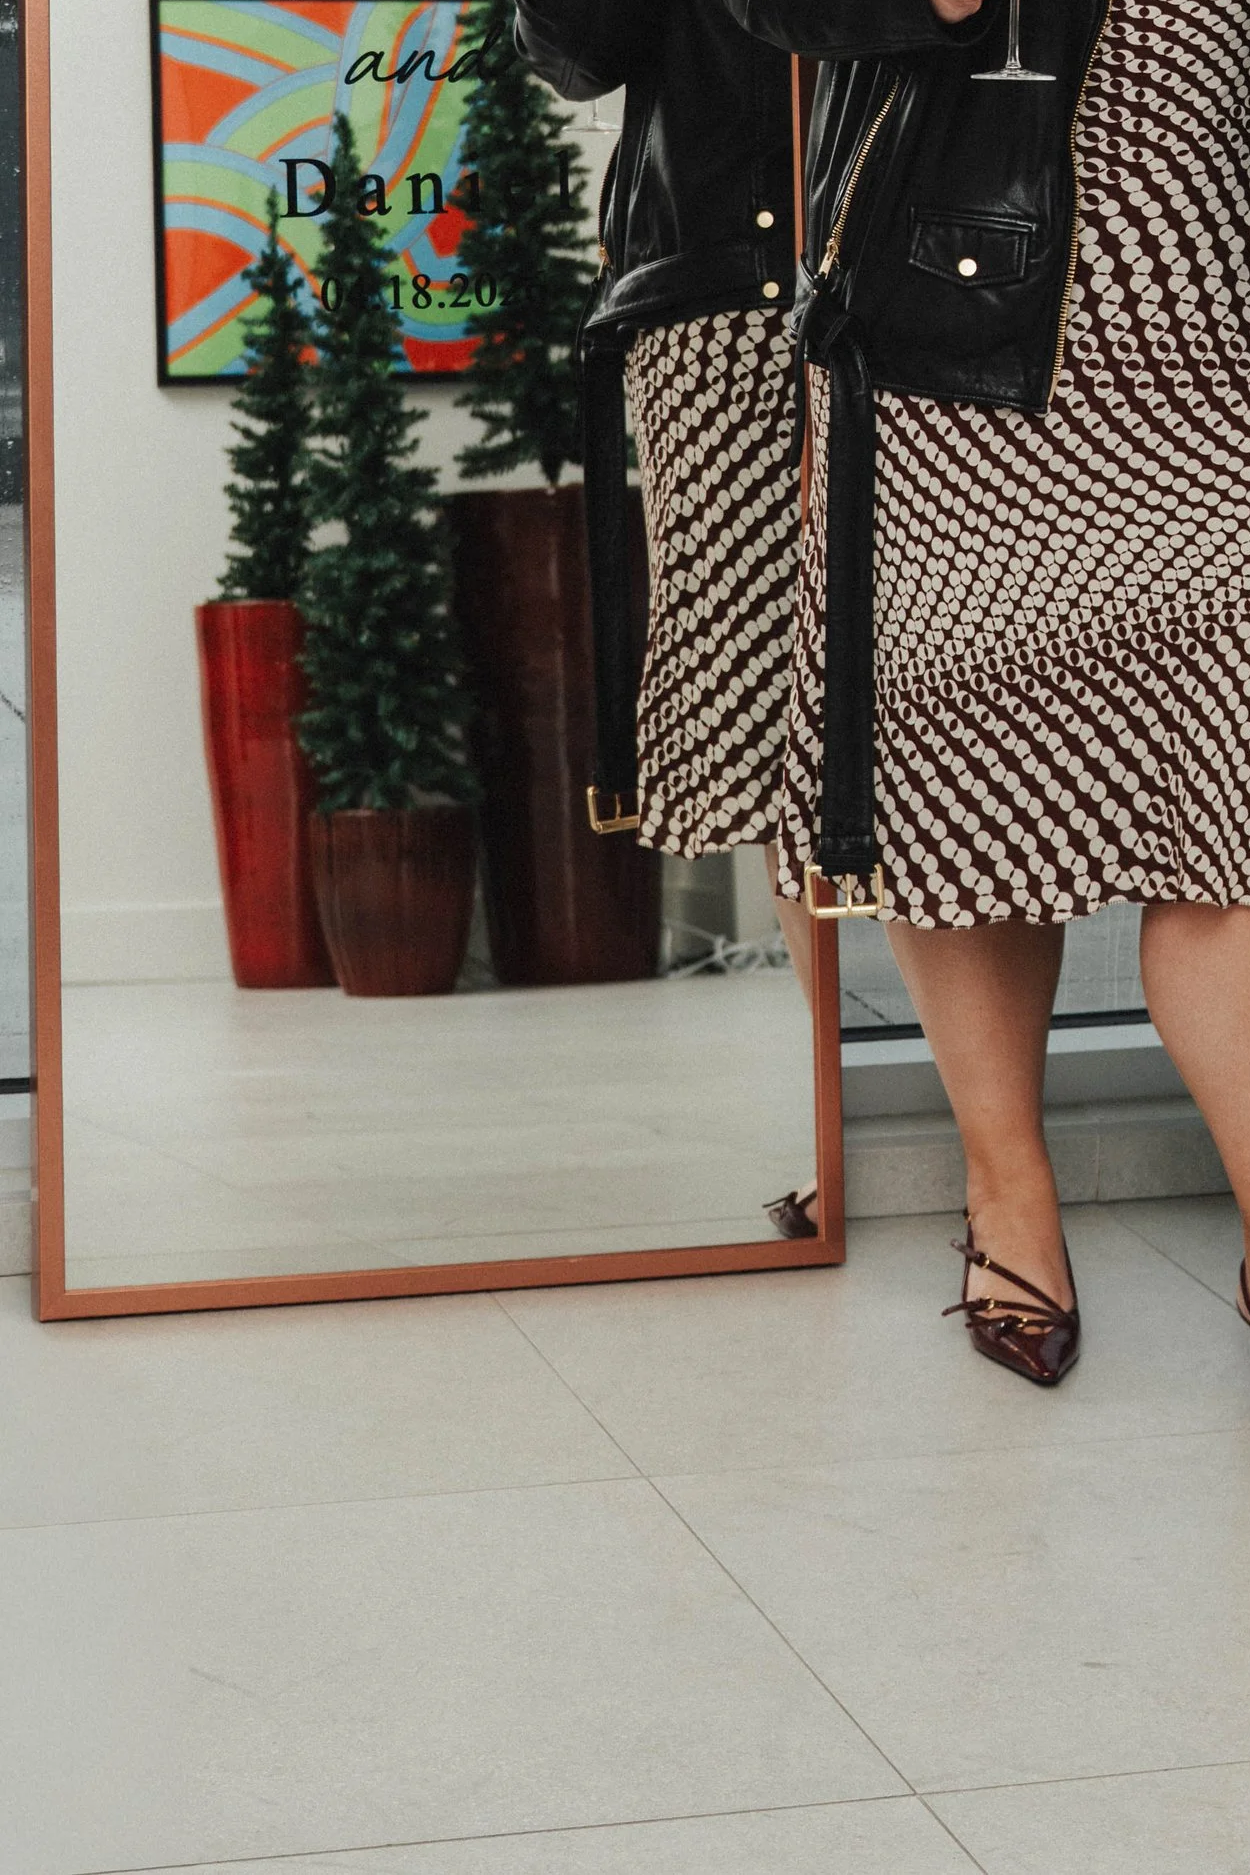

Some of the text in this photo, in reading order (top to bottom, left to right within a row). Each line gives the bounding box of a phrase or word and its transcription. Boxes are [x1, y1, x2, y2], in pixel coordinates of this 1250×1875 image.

[344, 20, 507, 86] and
[279, 150, 576, 219] Danil
[320, 272, 548, 312] 0.18.20
